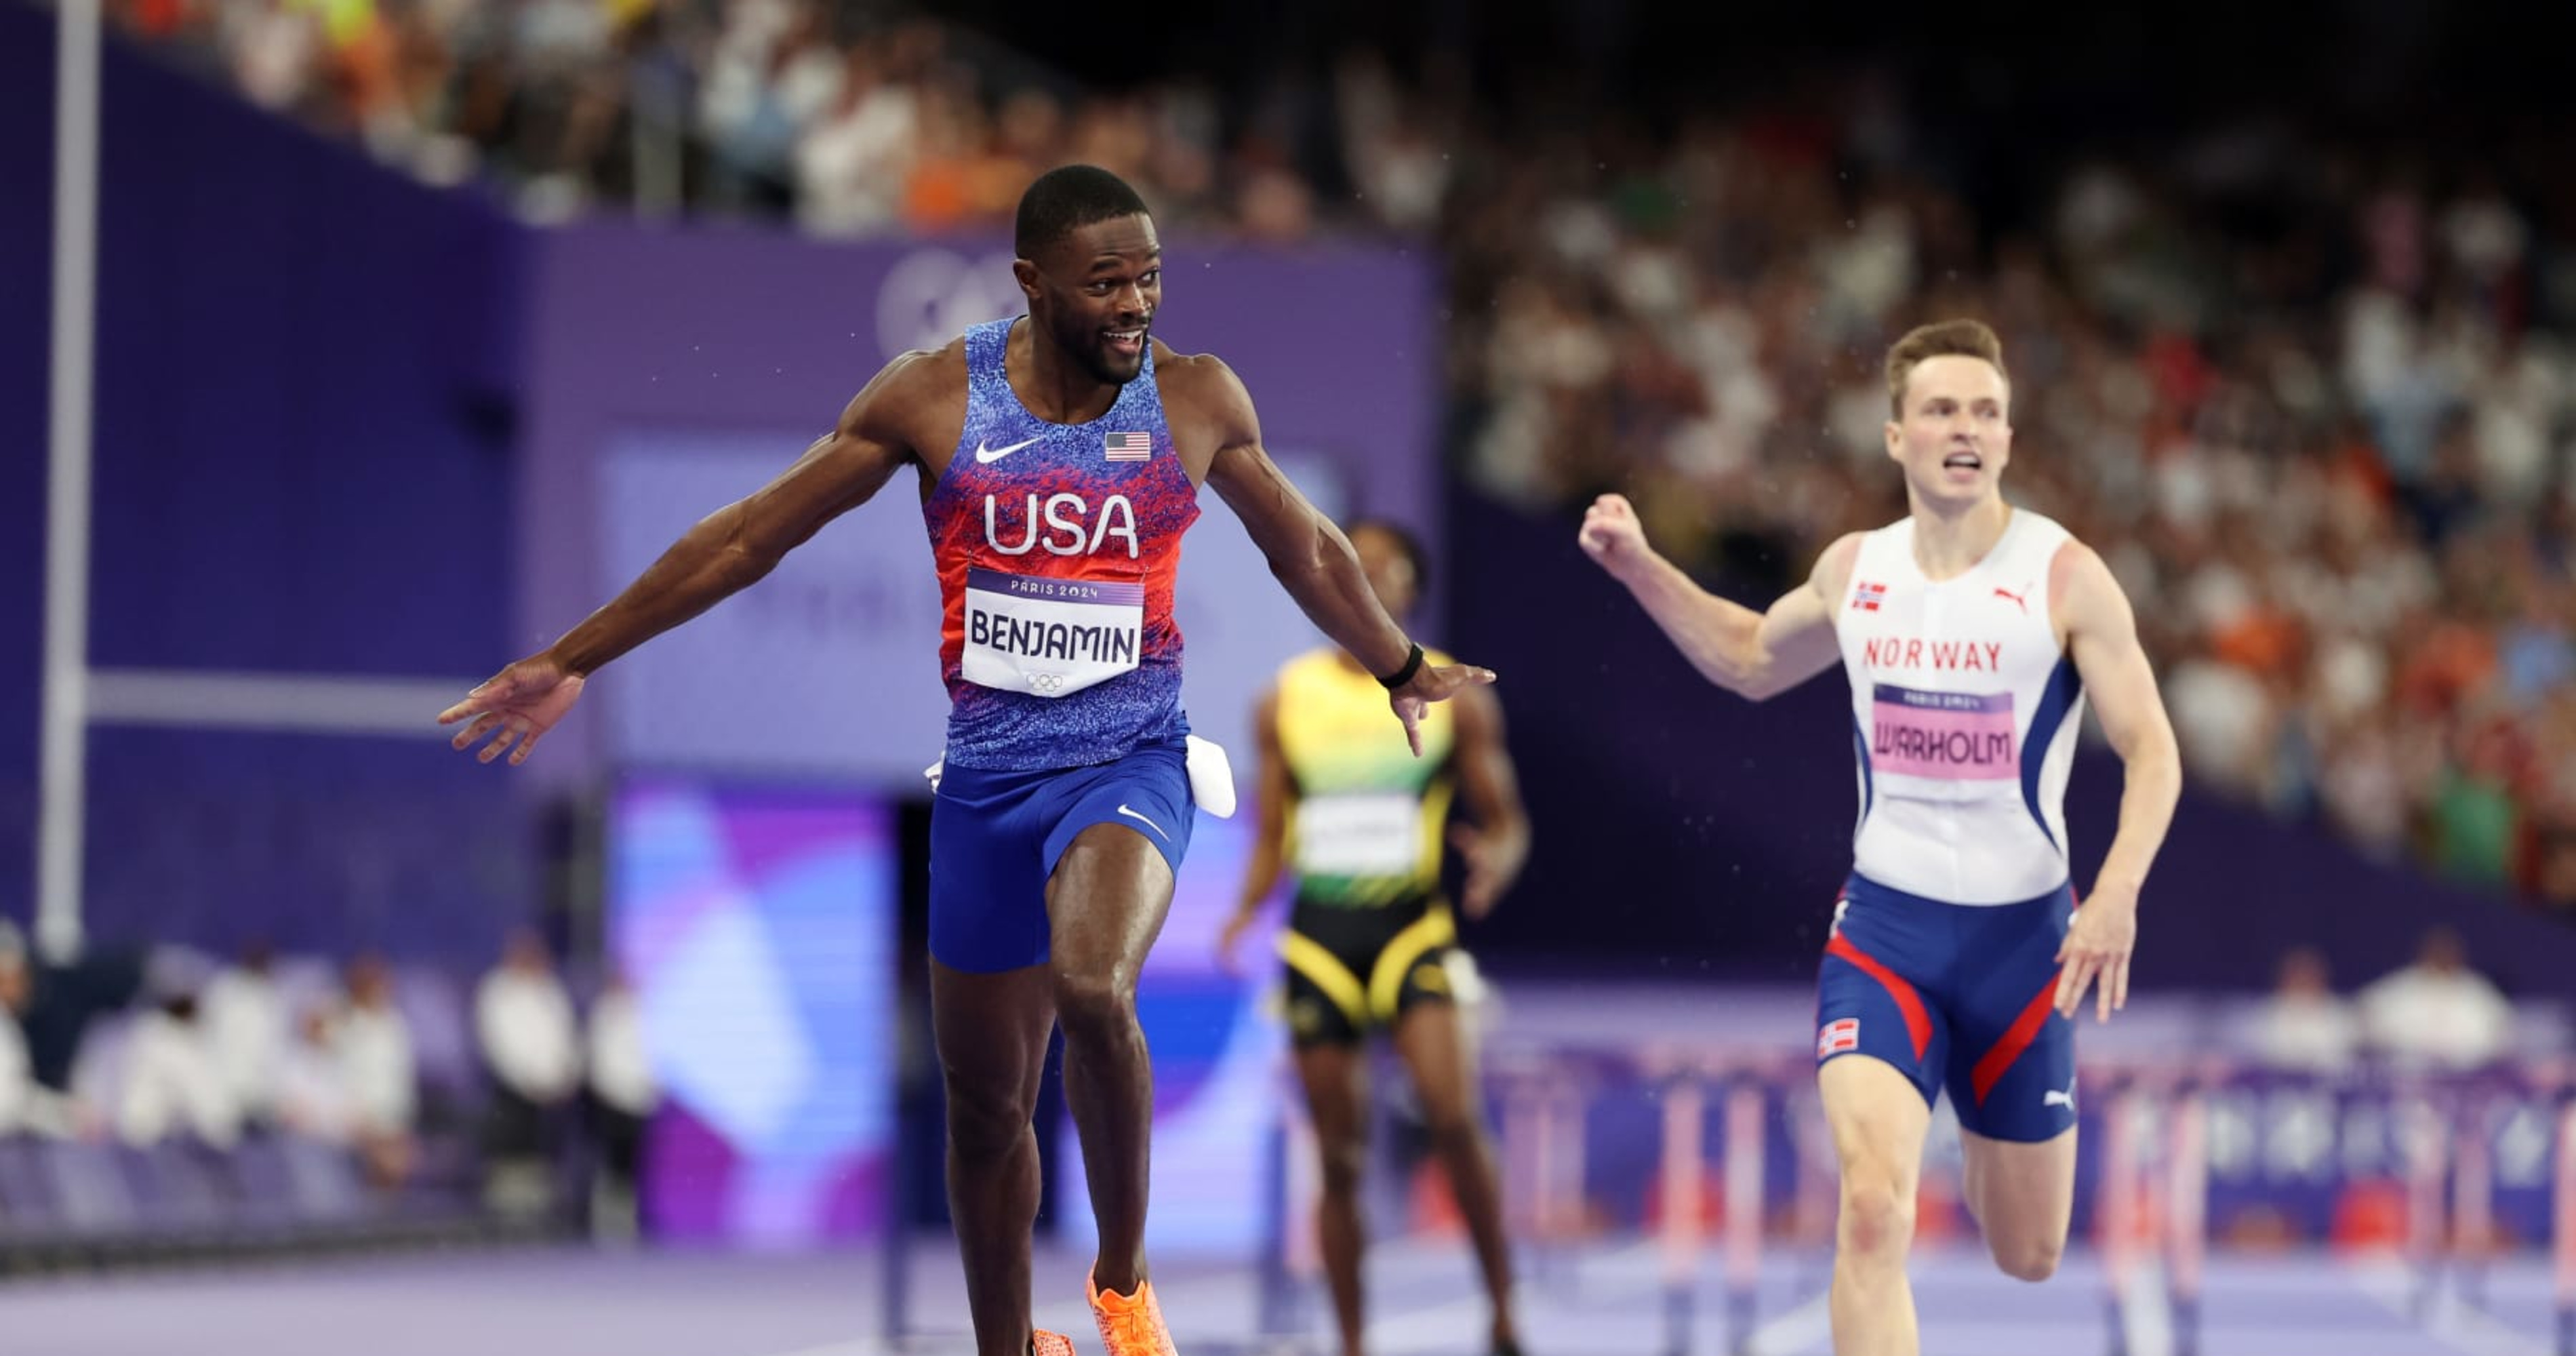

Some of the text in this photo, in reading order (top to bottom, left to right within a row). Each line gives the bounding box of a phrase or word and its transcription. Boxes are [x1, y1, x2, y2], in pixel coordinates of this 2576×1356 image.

[985, 493, 1139, 559] USA
[1011, 580, 1098, 598] PARIS 2024
[971, 609, 1135, 664] BENJAMIN
[1863, 637, 2001, 672] NORWAY
[1874, 721, 2011, 765] WARHOLM
